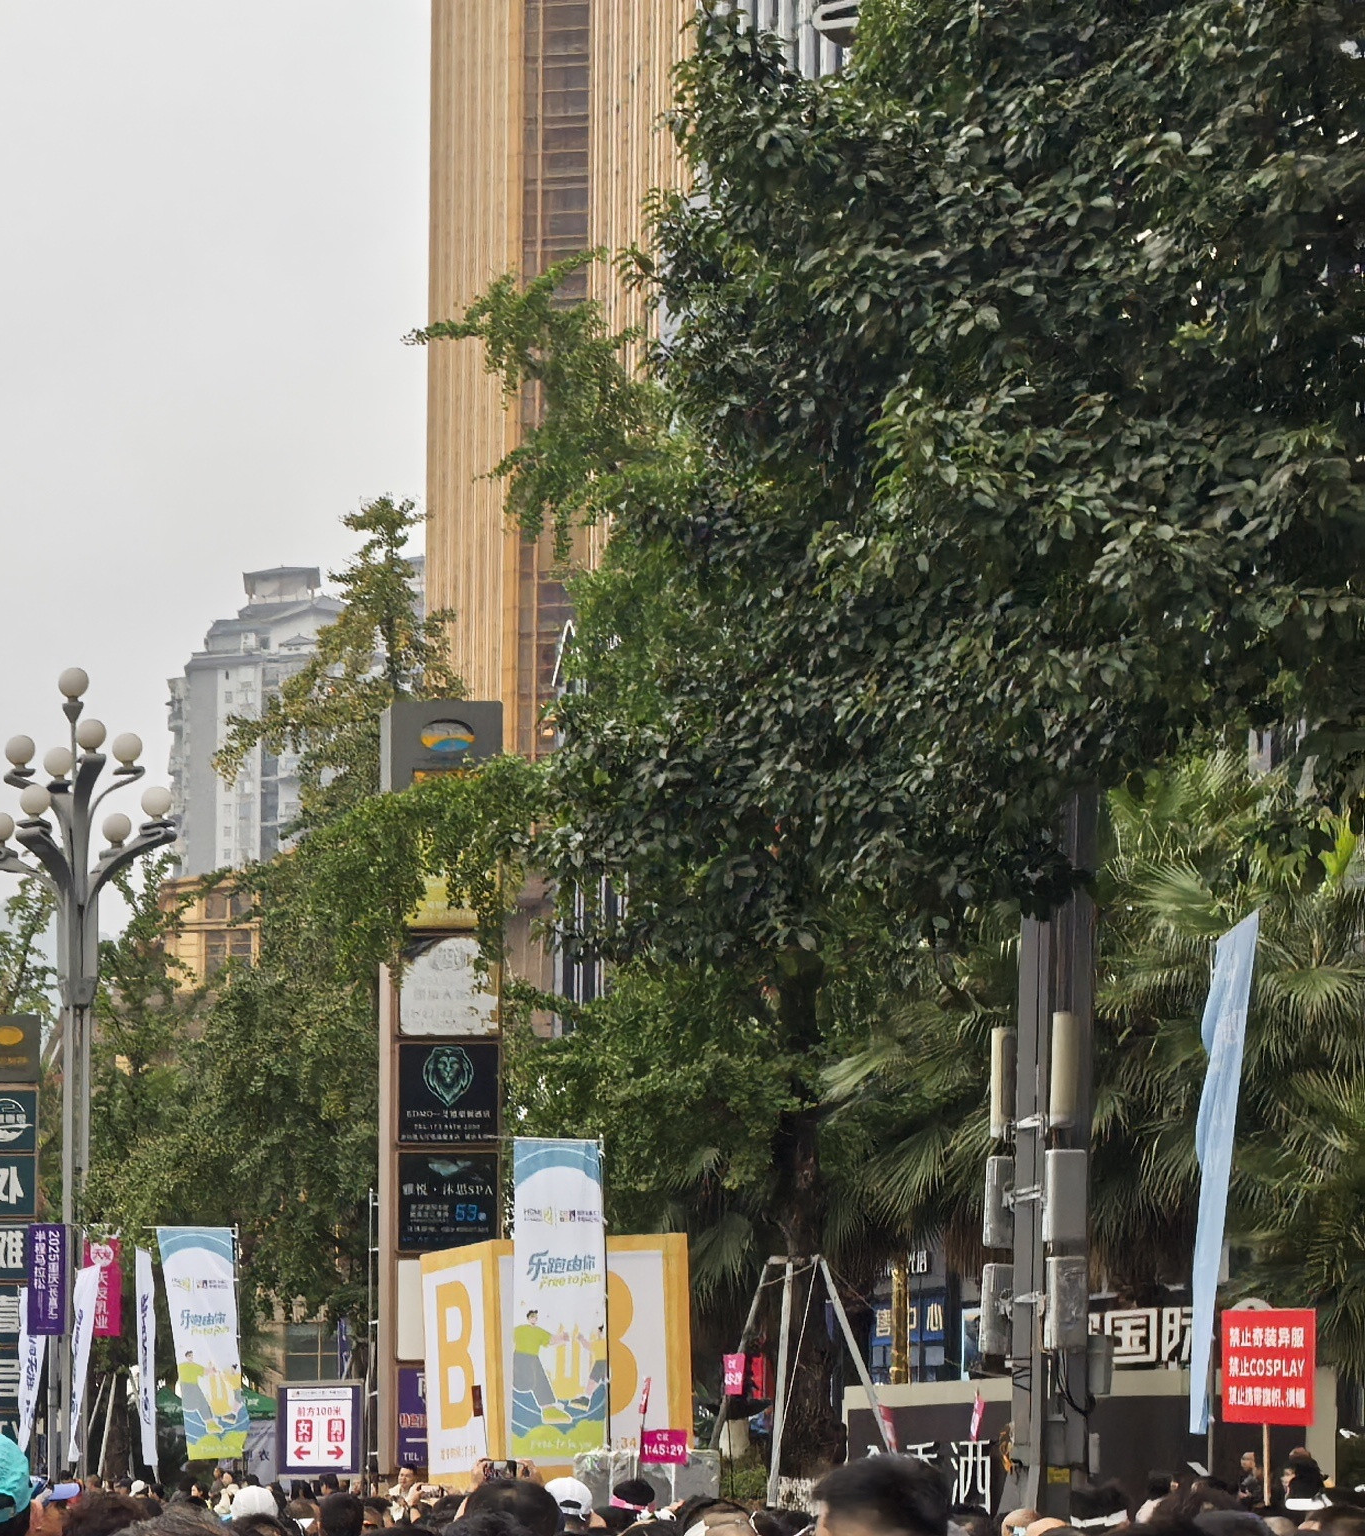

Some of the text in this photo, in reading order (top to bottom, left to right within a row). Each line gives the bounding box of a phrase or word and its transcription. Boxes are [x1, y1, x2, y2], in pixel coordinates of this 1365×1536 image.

[1229, 1326, 1305, 1348] 禁止奇装异服
[435, 1280, 475, 1430] B
[1228, 1356, 1305, 1378] 禁止COSPLAY
[297, 1406, 341, 1417] 前方100米
[297, 1419, 311, 1434] 女
